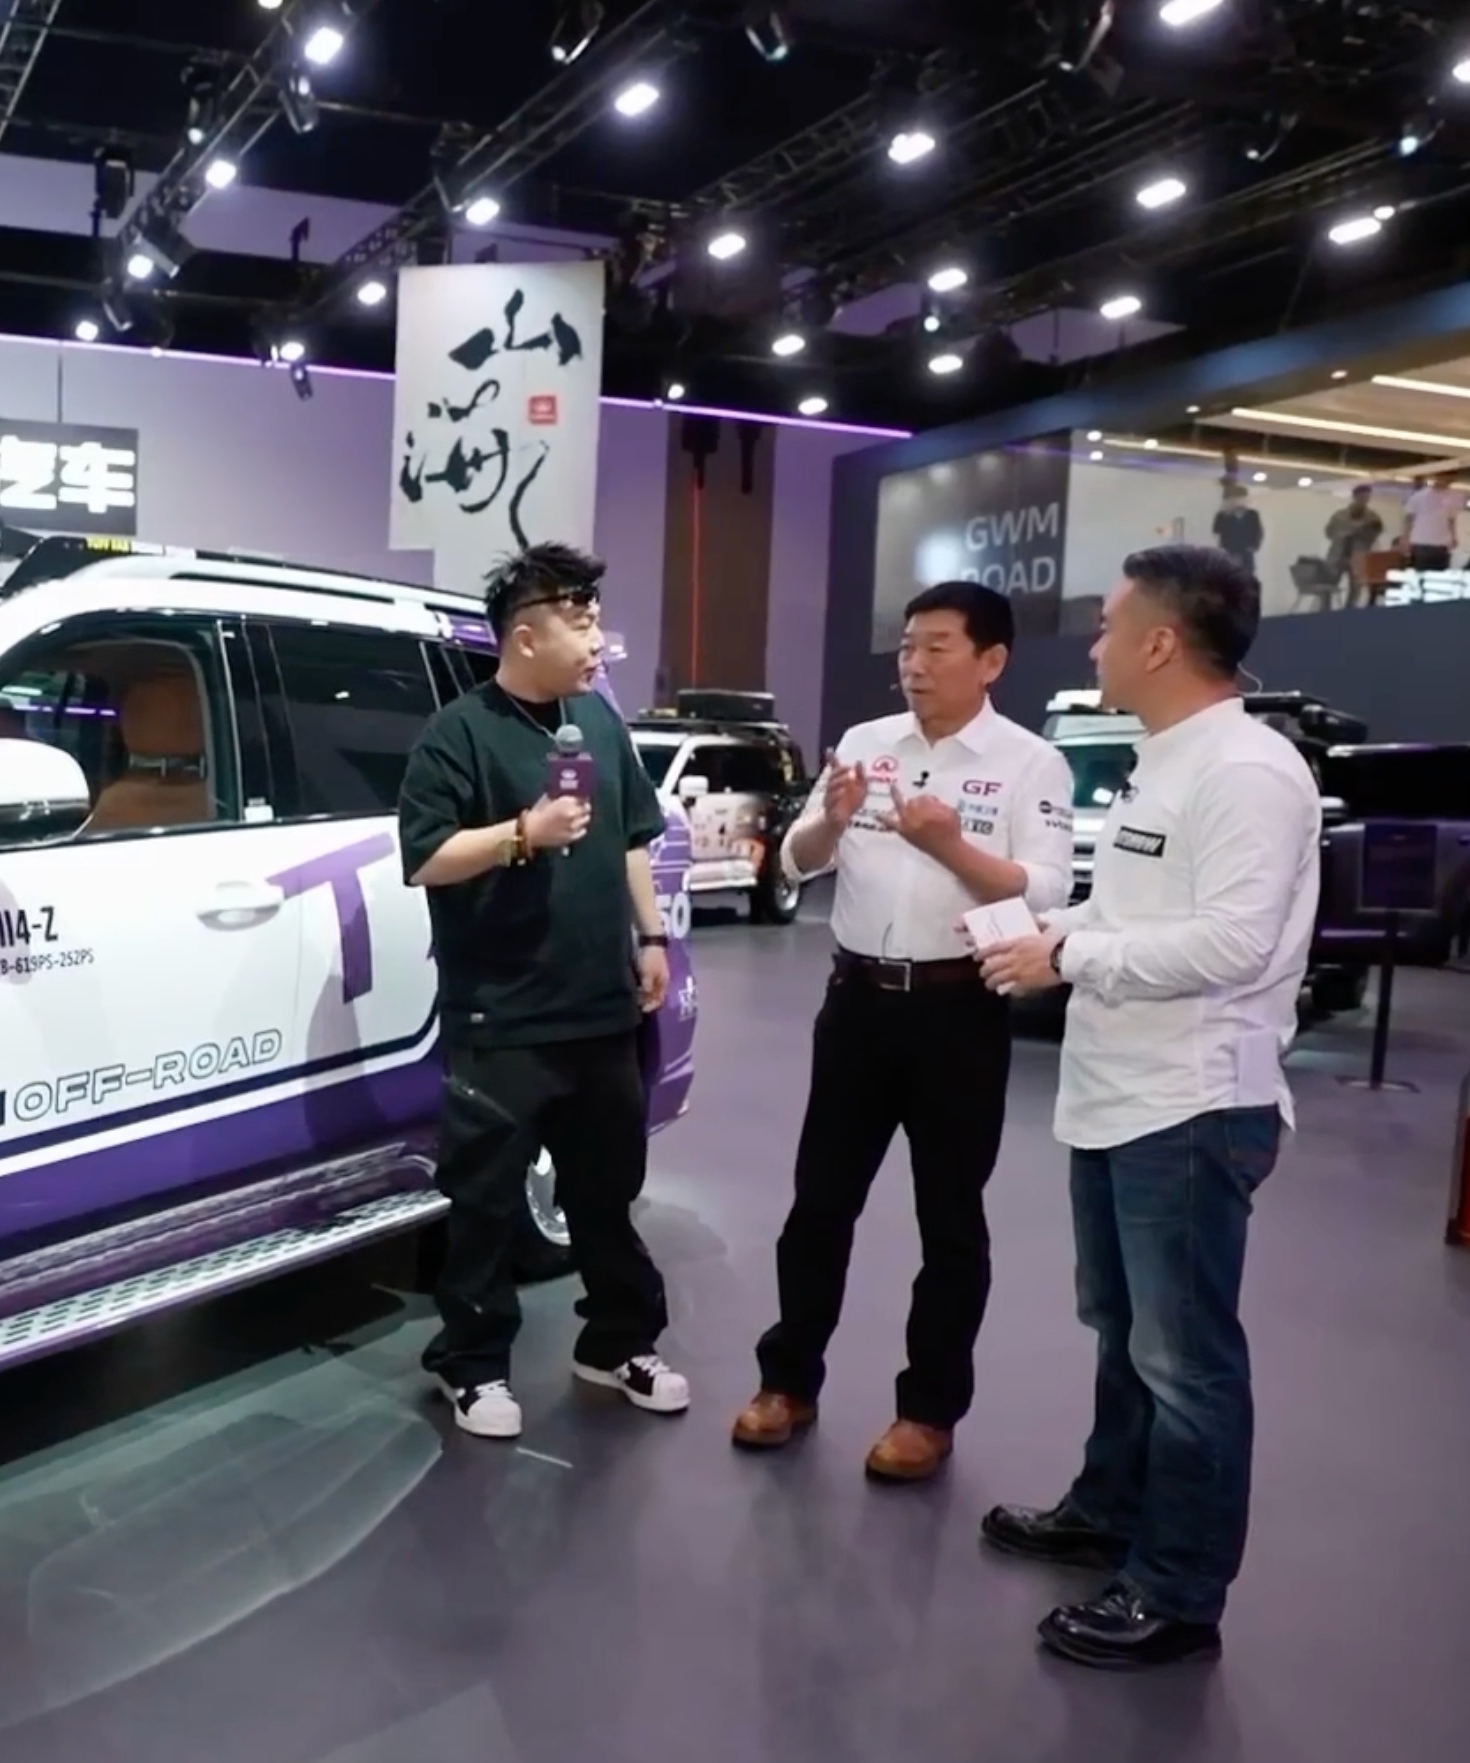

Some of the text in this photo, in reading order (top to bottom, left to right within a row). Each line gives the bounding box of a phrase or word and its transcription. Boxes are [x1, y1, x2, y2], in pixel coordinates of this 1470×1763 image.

[965, 502, 1060, 551] GWM
[962, 780, 1002, 796] GF
[12, 1028, 283, 1123] OFF-ROAD
